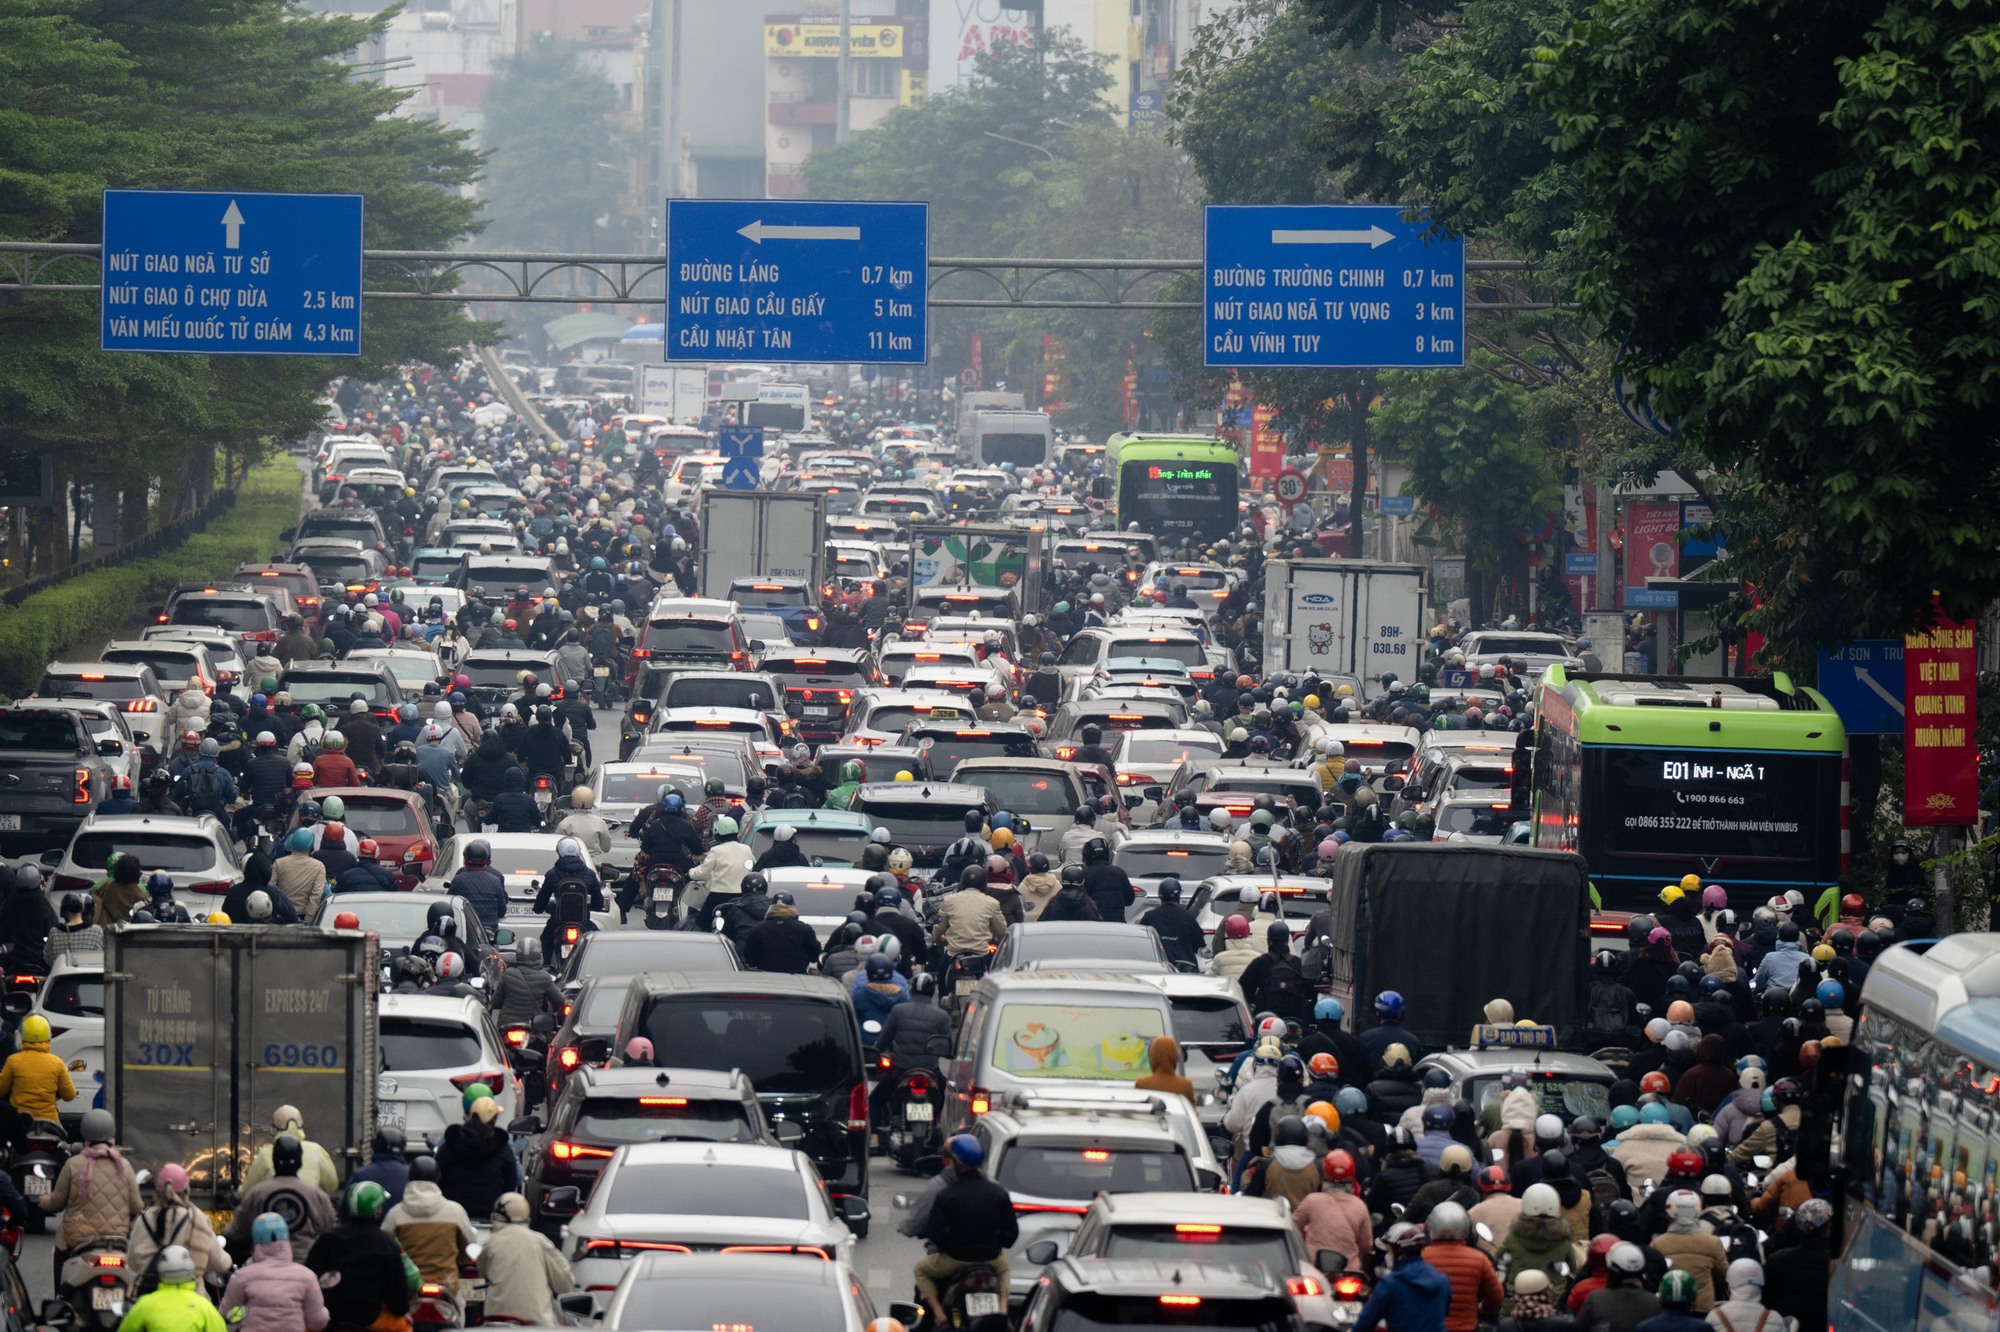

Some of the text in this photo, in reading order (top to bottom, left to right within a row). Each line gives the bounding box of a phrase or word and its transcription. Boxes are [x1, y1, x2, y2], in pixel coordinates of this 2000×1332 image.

[109, 248, 270, 275] NÚT GIAO NGÃ TƯ SỞ
[680, 258, 779, 283] ĐƯỜNG LÁNG
[861, 266, 913, 285] 0,7 km
[1213, 263, 1385, 287] ĐƯỜNG TRƯỜNG CHINH
[1403, 269, 1454, 289] 0,7 km
[109, 281, 268, 310] NÚT GIAO Ô CHỢ DỪA
[303, 291, 355, 310] 2,5 km
[680, 291, 826, 316] NÚT GIAO CẦU GIẤY
[874, 299, 913, 317] 5 km
[1214, 296, 1390, 324] NÚT GIAO NGÃ TƯ VỌNG
[1415, 302, 1454, 320] 3 km
[109, 313, 292, 341] VĂN MIẾU QUỐC TỬ GIÁM
[303, 324, 354, 343] 4,3 km
[680, 324, 792, 350] CẦU NHẬT TÂN
[868, 331, 912, 350] 11 km
[1214, 329, 1321, 353] CẦU VĨNH TUY
[1415, 335, 1454, 353] 8 km
[1634, 523, 1679, 534] LIGHT BO
[1380, 625, 1403, 638] 89H-
[1931, 626, 1953, 653] CỘNG
[1373, 643, 1406, 655] 030.68
[1849, 647, 1871, 661] SƠN
[1919, 658, 1960, 686] VIỆT NAM
[1914, 695, 1965, 716] QUANG VINH
[1915, 724, 1966, 747] MUÔN NĂM!
[1663, 761, 1689, 780] E01
[1726, 763, 1754, 780] NGÃ
[1758, 767, 1765, 780] T
[1685, 794, 1744, 805] 1900 866 663
[1625, 817, 1637, 829] GỌI
[1638, 816, 1658, 828] 0866
[1659, 817, 1675, 829] 355
[1676, 817, 1691, 829] 222
[1692, 816, 1702, 830] ĐỂ
[1715, 819, 1738, 831] THÀNH
[1739, 820, 1758, 832] NHÂN
[1758, 820, 1774, 832] VIÊN
[1774, 822, 1799, 833] VINBUS
[265, 988, 307, 1013] EXPRESS
[1500, 1031, 1516, 1044] SAO
[137, 1043, 194, 1067] 30X
[264, 1043, 338, 1067] 6960
